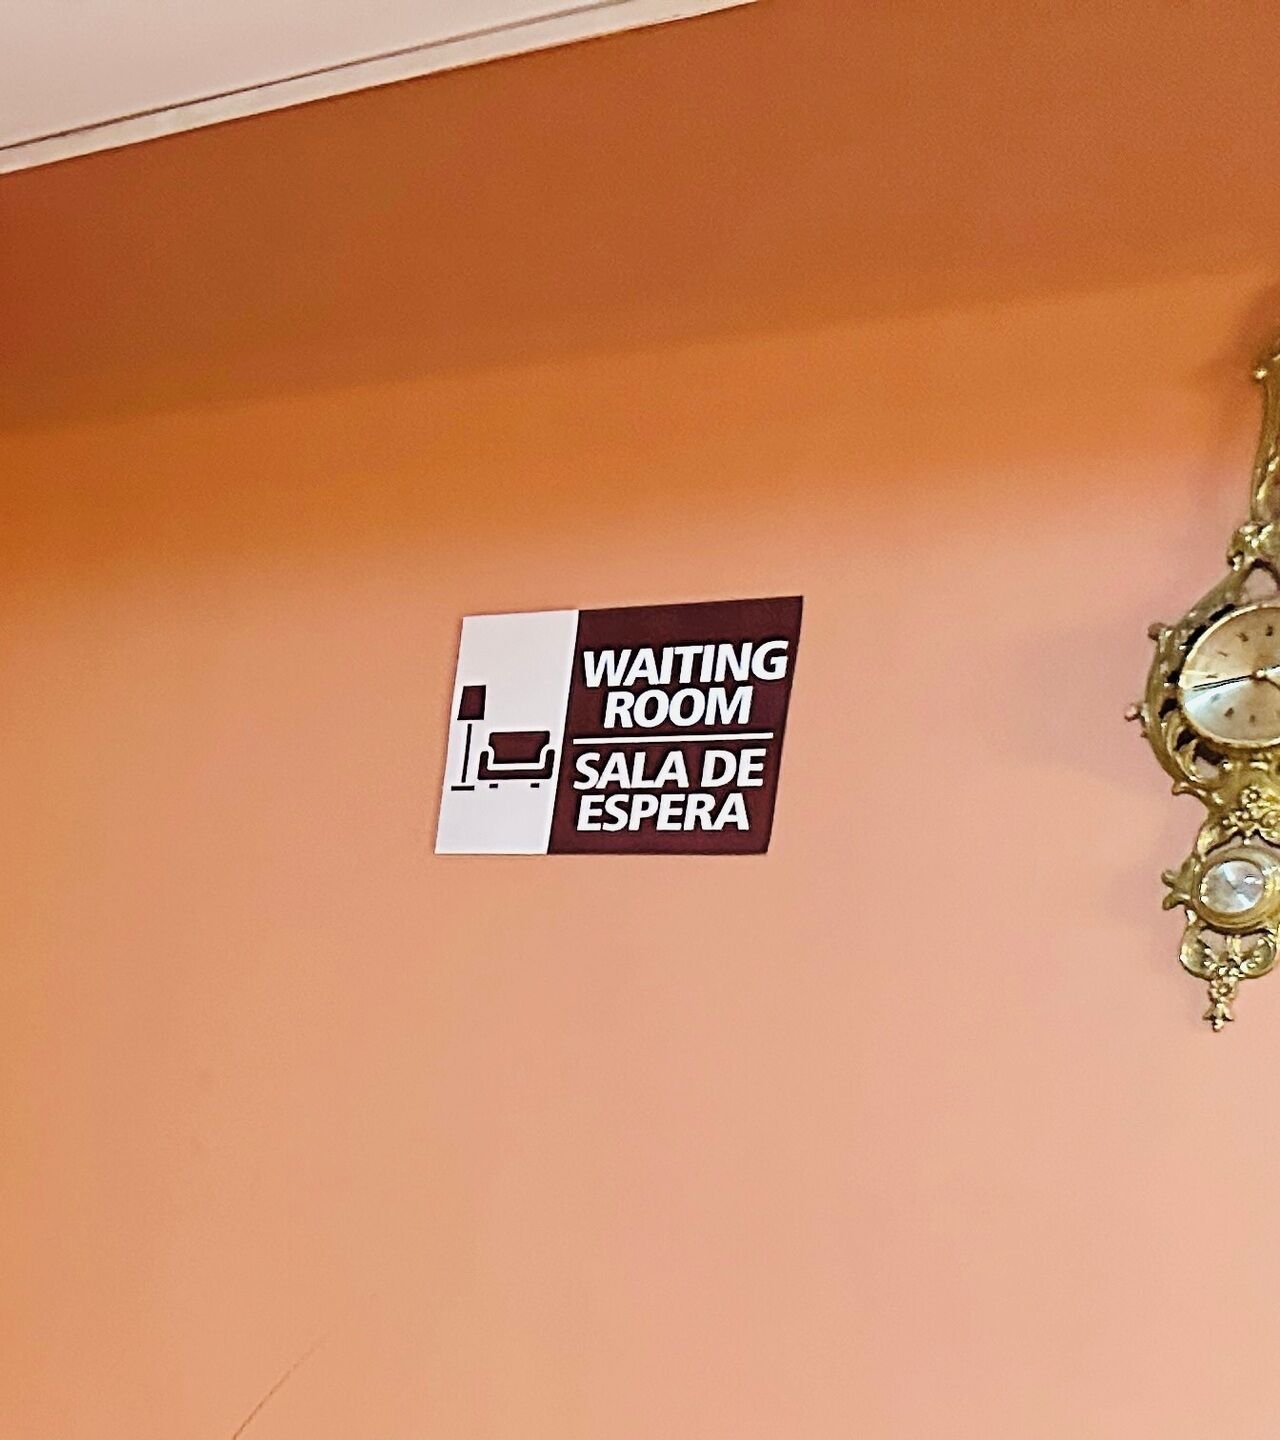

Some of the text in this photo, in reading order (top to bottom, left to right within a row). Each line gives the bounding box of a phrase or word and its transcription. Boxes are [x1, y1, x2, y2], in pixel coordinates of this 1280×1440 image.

[583, 640, 789, 688] WAITING
[603, 685, 754, 729] ROOM
[573, 748, 767, 790] SALA DE
[576, 792, 750, 832] ESPERA
